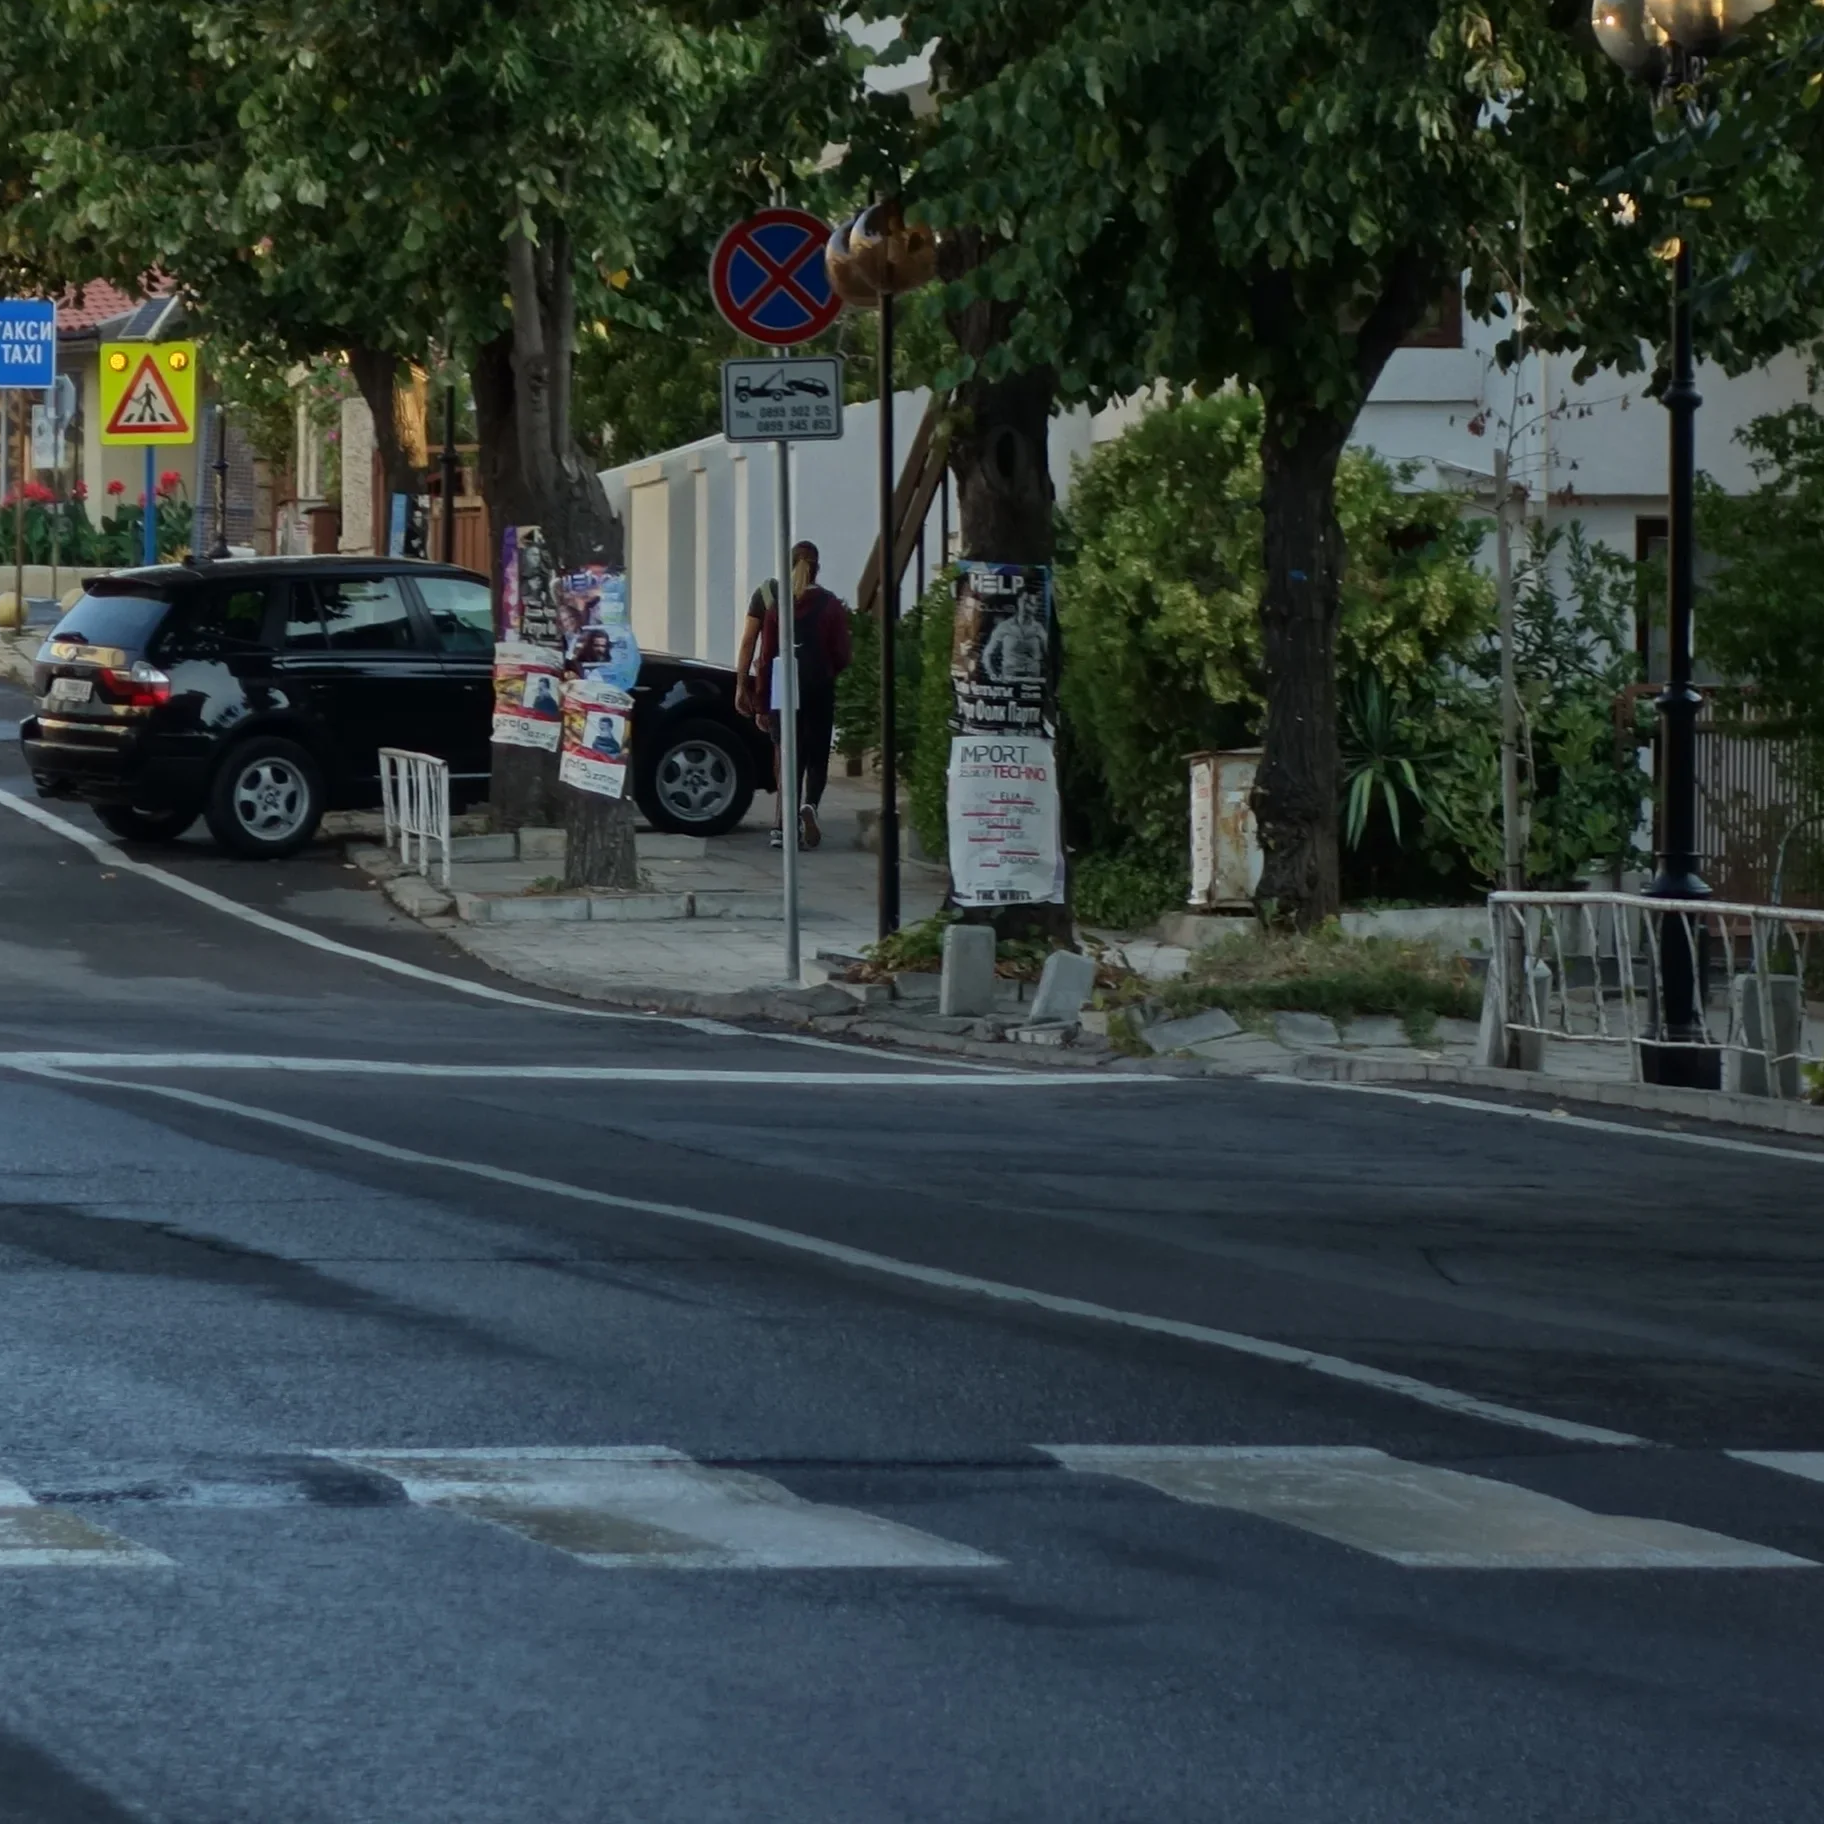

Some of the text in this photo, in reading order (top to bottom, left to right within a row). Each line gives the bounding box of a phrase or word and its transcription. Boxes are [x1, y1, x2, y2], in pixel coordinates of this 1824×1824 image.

[1, 344, 43, 365] TAXI
[968, 573, 1025, 595] HELP
[975, 699, 1007, 721] Фолк
[960, 745, 1030, 764] IMPORT
